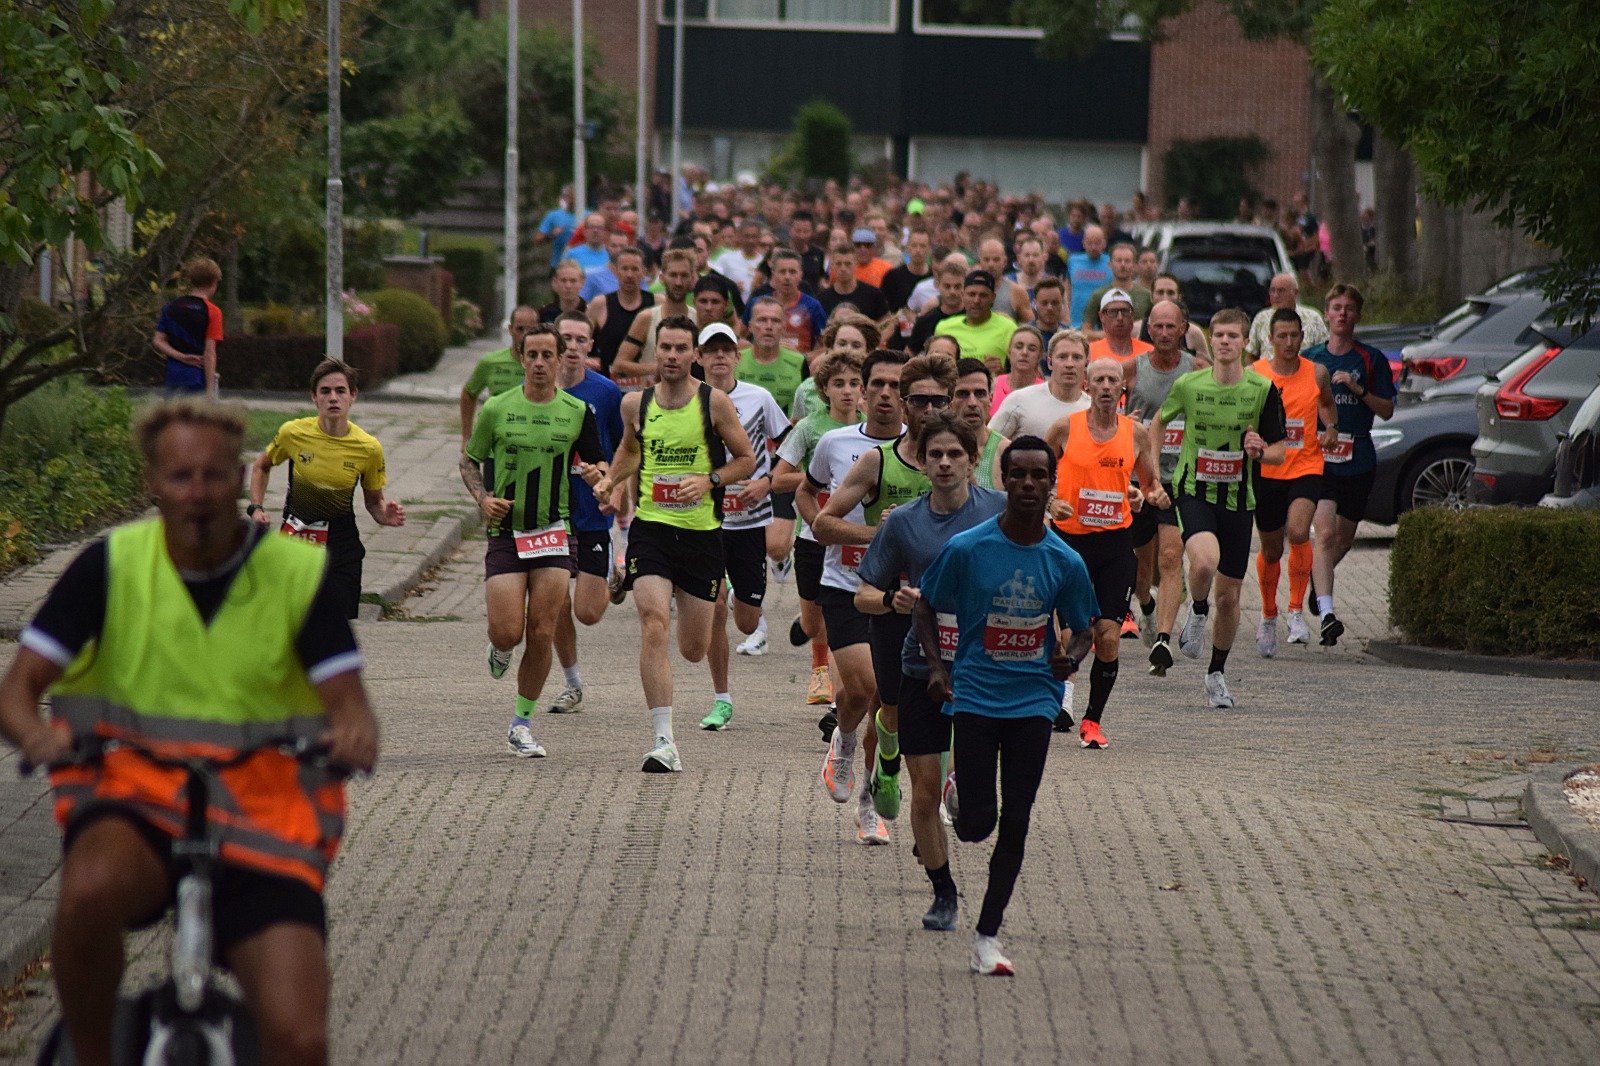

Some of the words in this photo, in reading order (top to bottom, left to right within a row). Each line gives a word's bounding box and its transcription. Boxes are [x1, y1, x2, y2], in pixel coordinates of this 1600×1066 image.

[665, 446, 700, 454] Zeeland
[655, 454, 697, 467] Running
[1205, 461, 1234, 473] 2533
[662, 488, 677, 500] 14
[1086, 503, 1115, 516] 2548
[526, 533, 558, 549] 1416
[997, 633, 1036, 647] 2436
